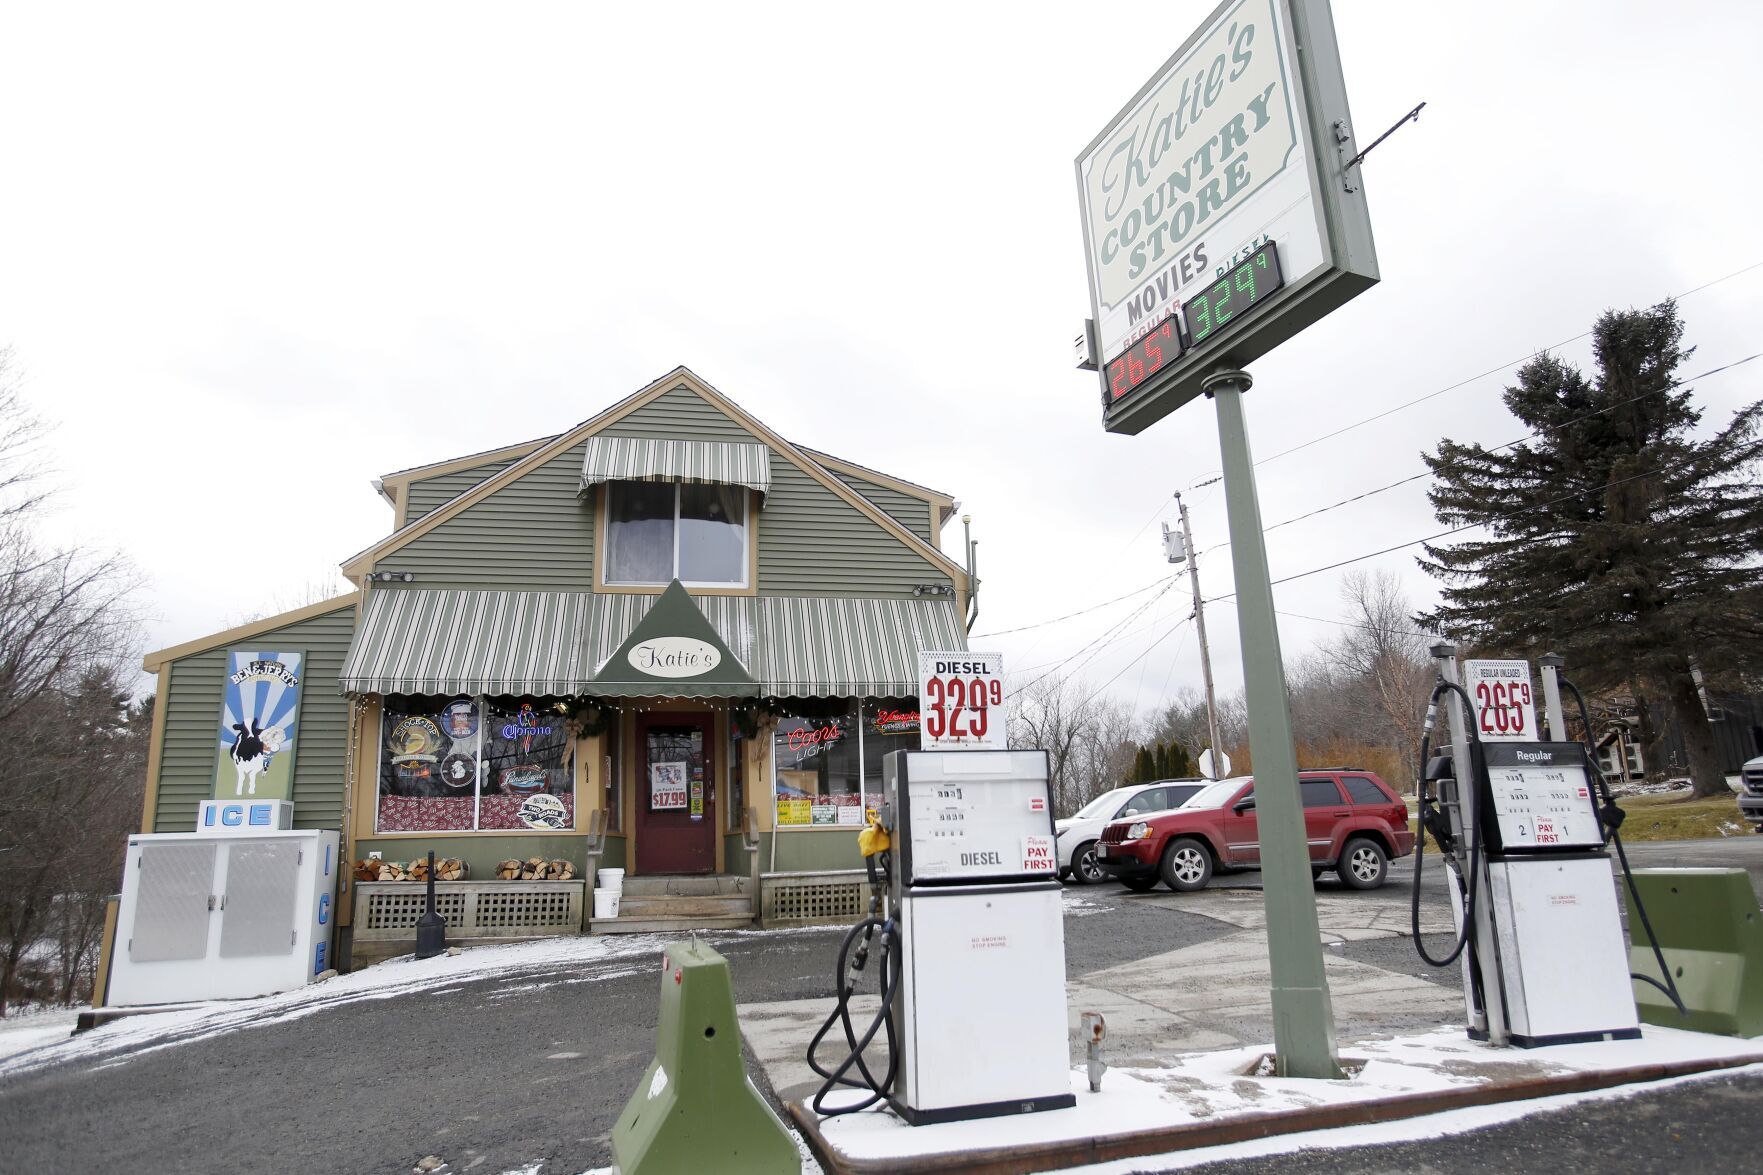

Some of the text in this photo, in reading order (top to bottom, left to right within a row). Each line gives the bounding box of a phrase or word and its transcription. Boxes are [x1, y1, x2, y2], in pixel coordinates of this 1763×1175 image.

[1101, 22, 1255, 222] Katie's
[1101, 81, 1277, 266] COUNTRY
[1128, 151, 1252, 280] STORE
[1215, 233, 1270, 279] DIESEL
[1126, 241, 1209, 327] MOVIES
[1123, 299, 1181, 351] REGULAR
[637, 646, 712, 669] Katie's
[936, 661, 991, 675] DIESEL
[1480, 668, 1521, 678] REGULAR UNLEADED
[503, 724, 552, 740] Corona
[787, 724, 840, 751] Coors
[796, 741, 835, 762] LIGHT
[1516, 750, 1552, 762] Regular
[652, 791, 687, 808] $17.99
[205, 804, 273, 826] ICE
[1518, 824, 1527, 836] 2
[1538, 824, 1554, 833] PAY
[1563, 825, 1569, 836] 1
[1536, 834, 1559, 843] FIRST
[960, 851, 1002, 867] DIESEL
[1027, 847, 1049, 858] PAY
[1024, 859, 1054, 870] FIRST
